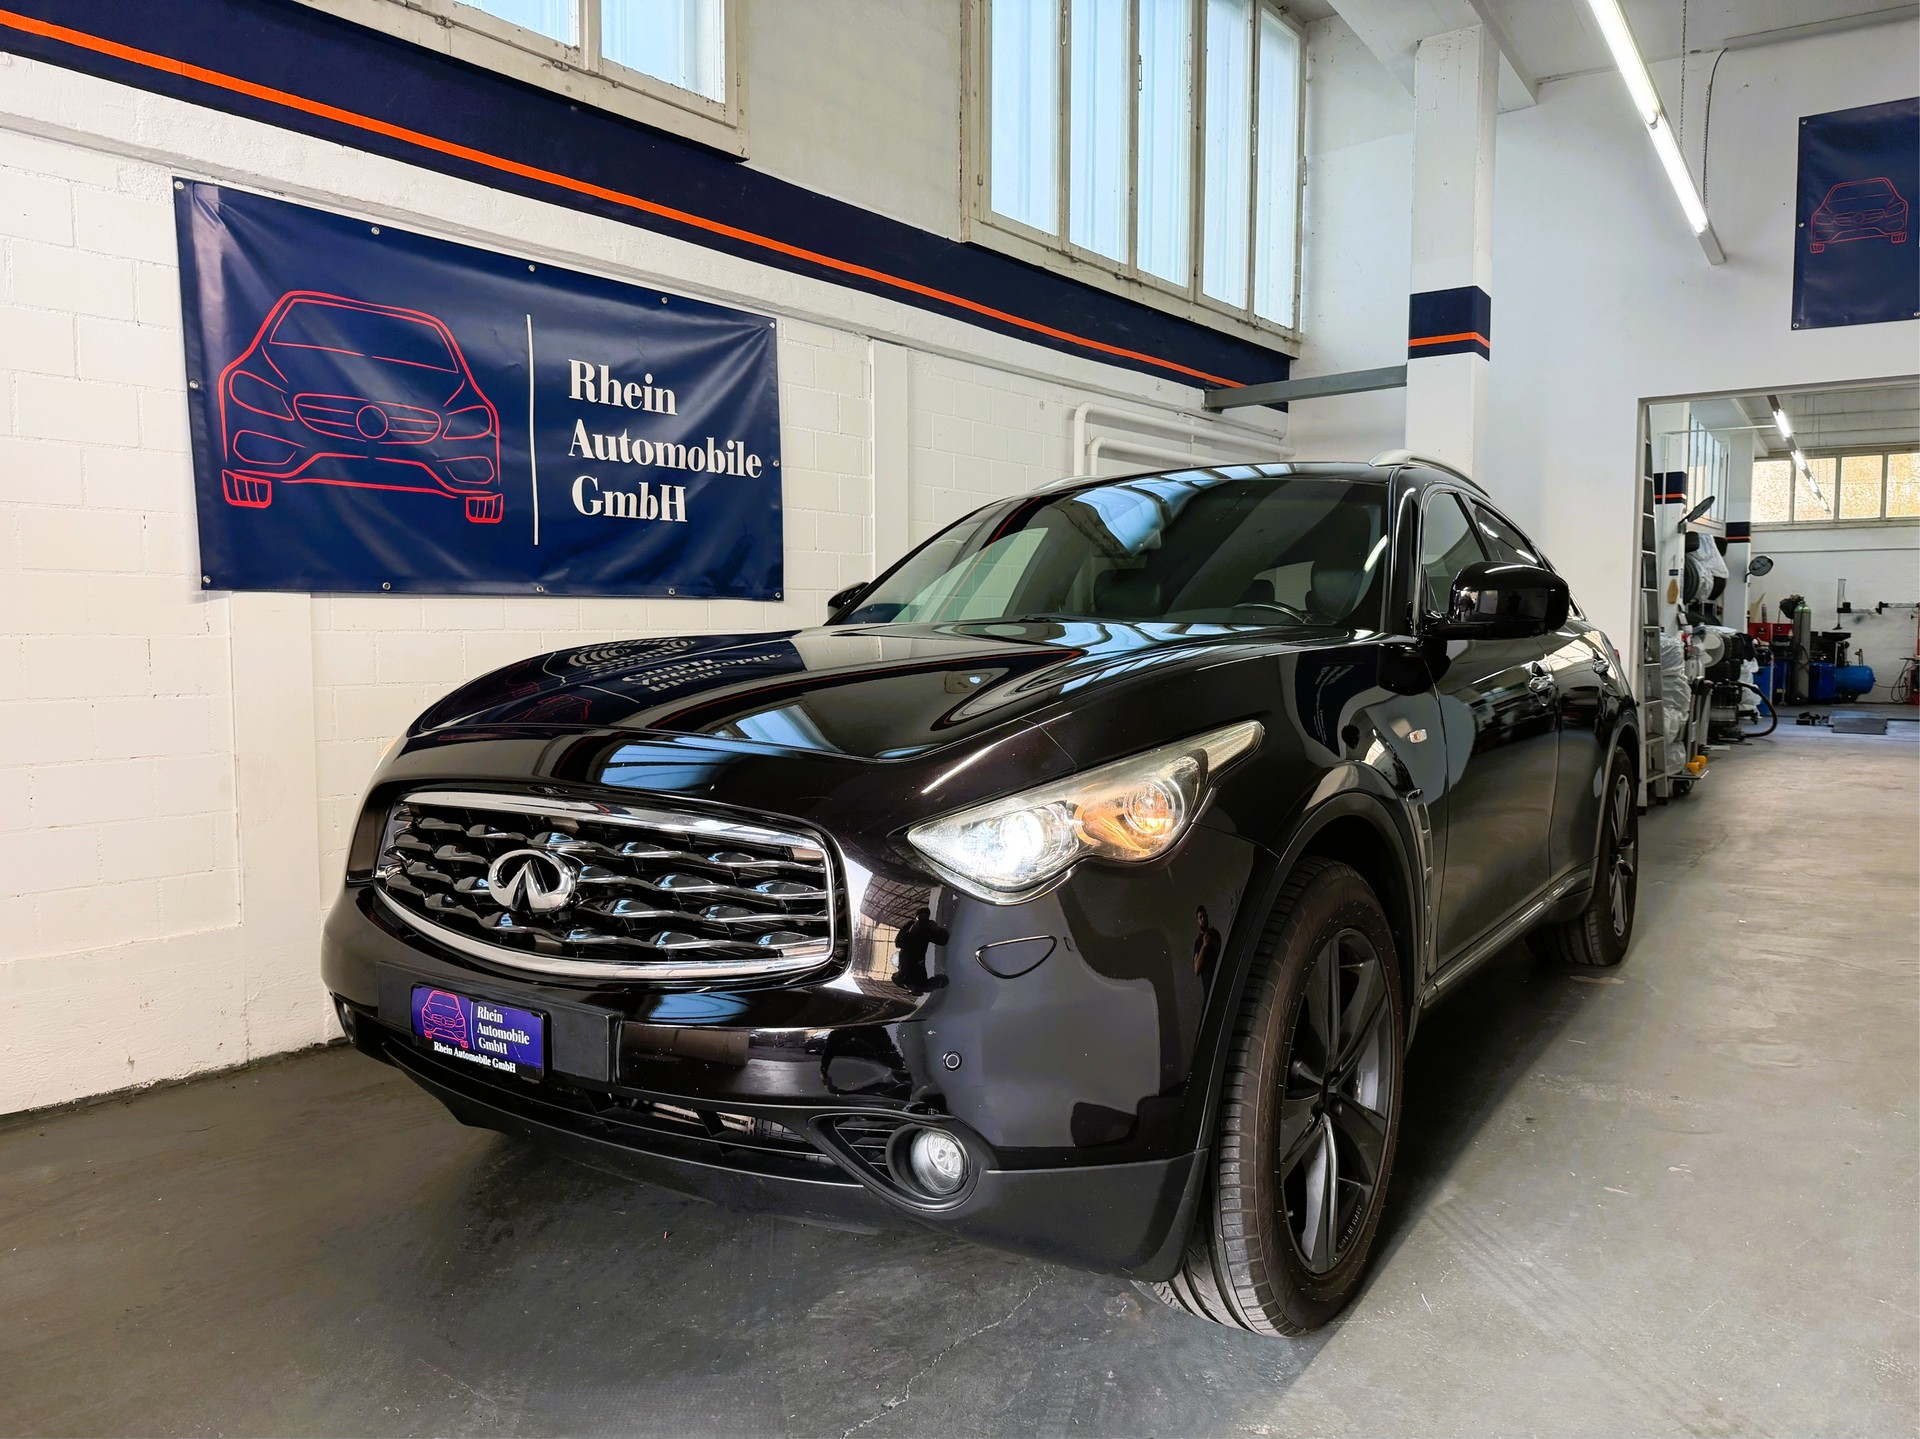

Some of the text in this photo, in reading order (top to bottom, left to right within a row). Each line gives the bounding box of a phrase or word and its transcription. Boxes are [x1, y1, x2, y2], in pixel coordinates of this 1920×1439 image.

[568, 359, 678, 415] Rhein
[568, 418, 763, 479] Automobile
[571, 475, 688, 523] GmbH
[477, 1006, 503, 1023] Rhein
[477, 1022, 530, 1045] Automobile
[478, 1036, 508, 1055] GmbH
[434, 1041, 516, 1073] Rhein Automobile GmbH
